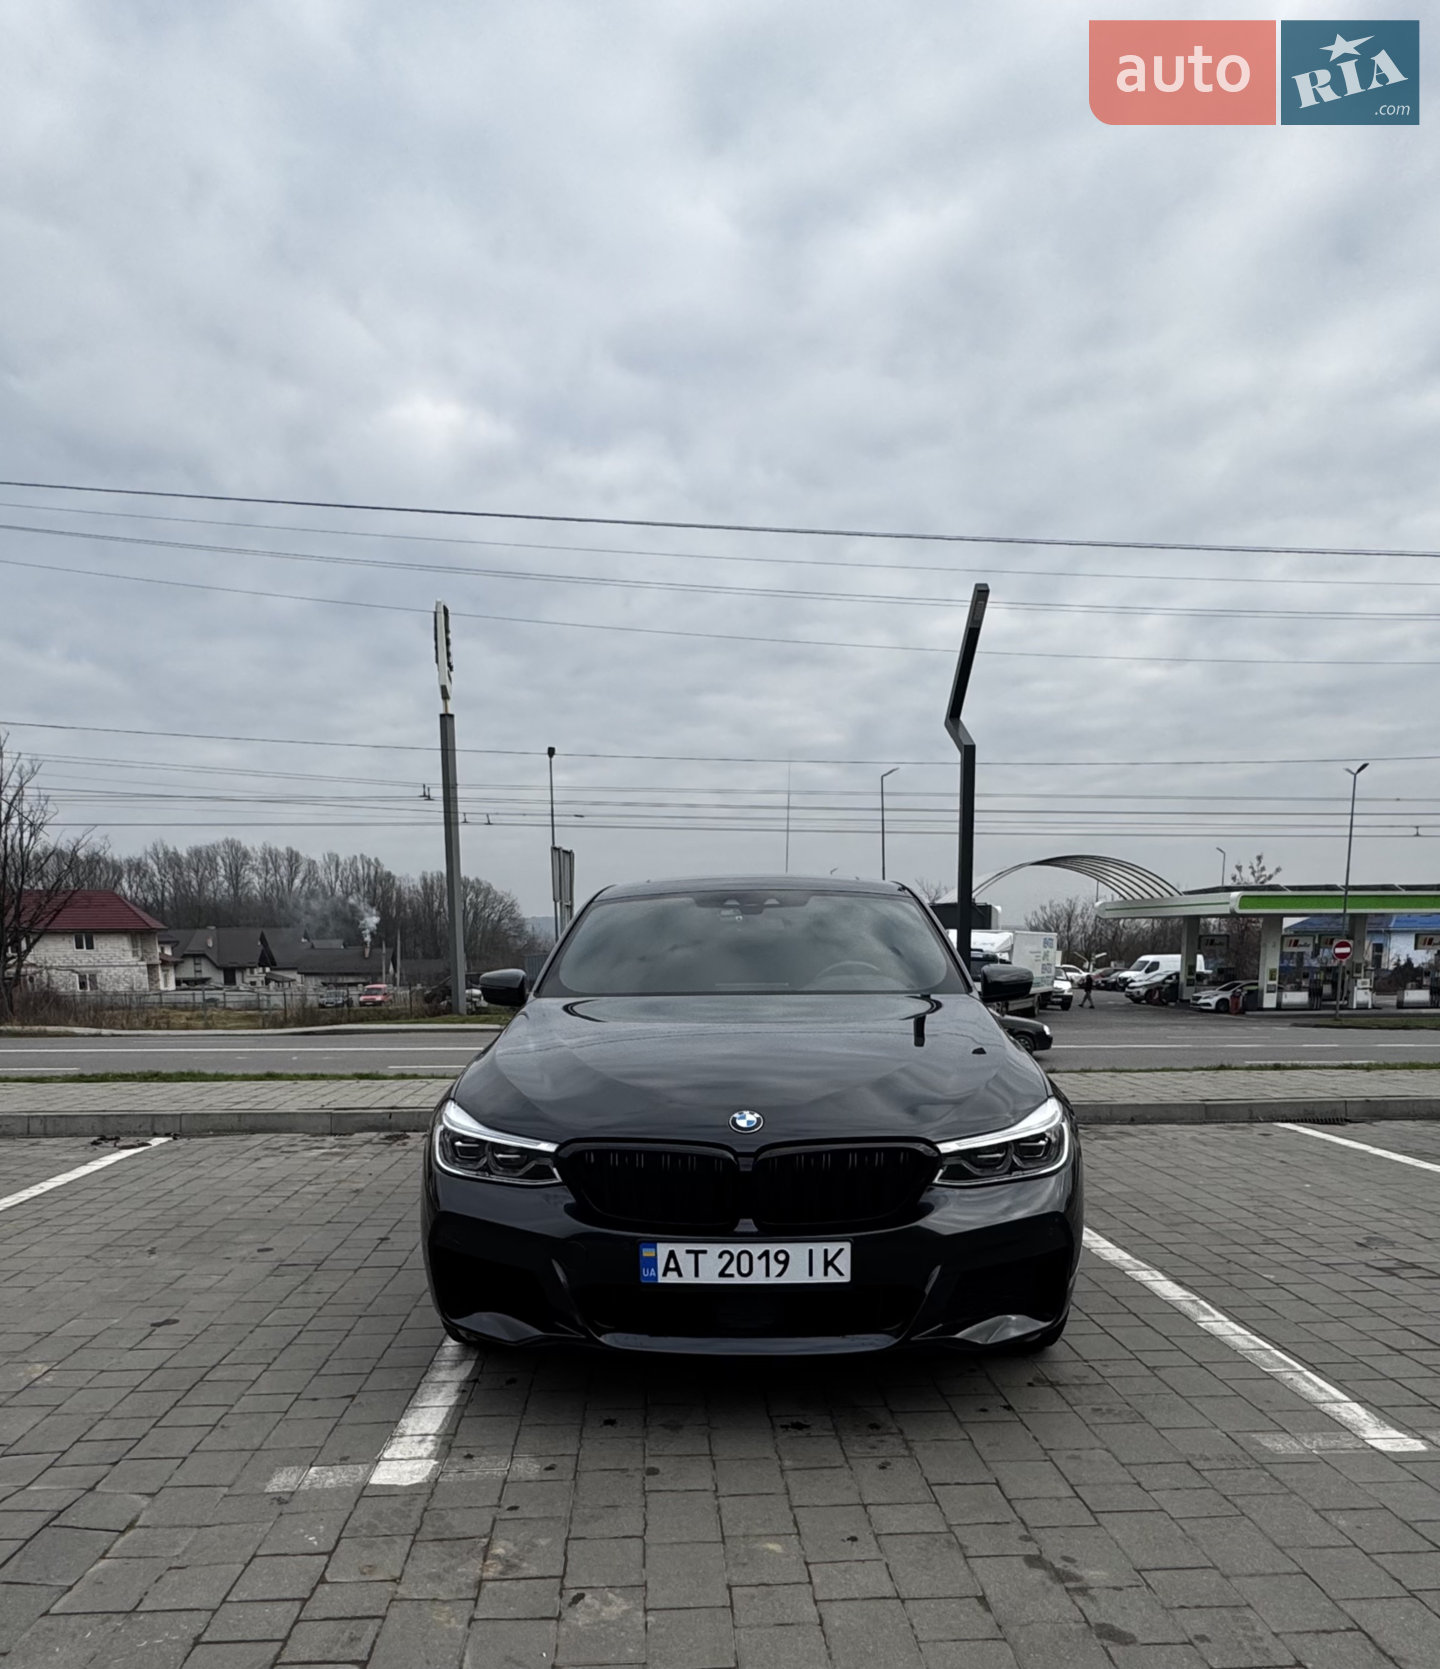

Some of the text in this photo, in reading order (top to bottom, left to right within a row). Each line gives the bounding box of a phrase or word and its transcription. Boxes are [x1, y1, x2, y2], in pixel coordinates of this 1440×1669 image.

[642, 1267, 657, 1277] UA
[661, 1248, 845, 1278] AT 2019 IK
